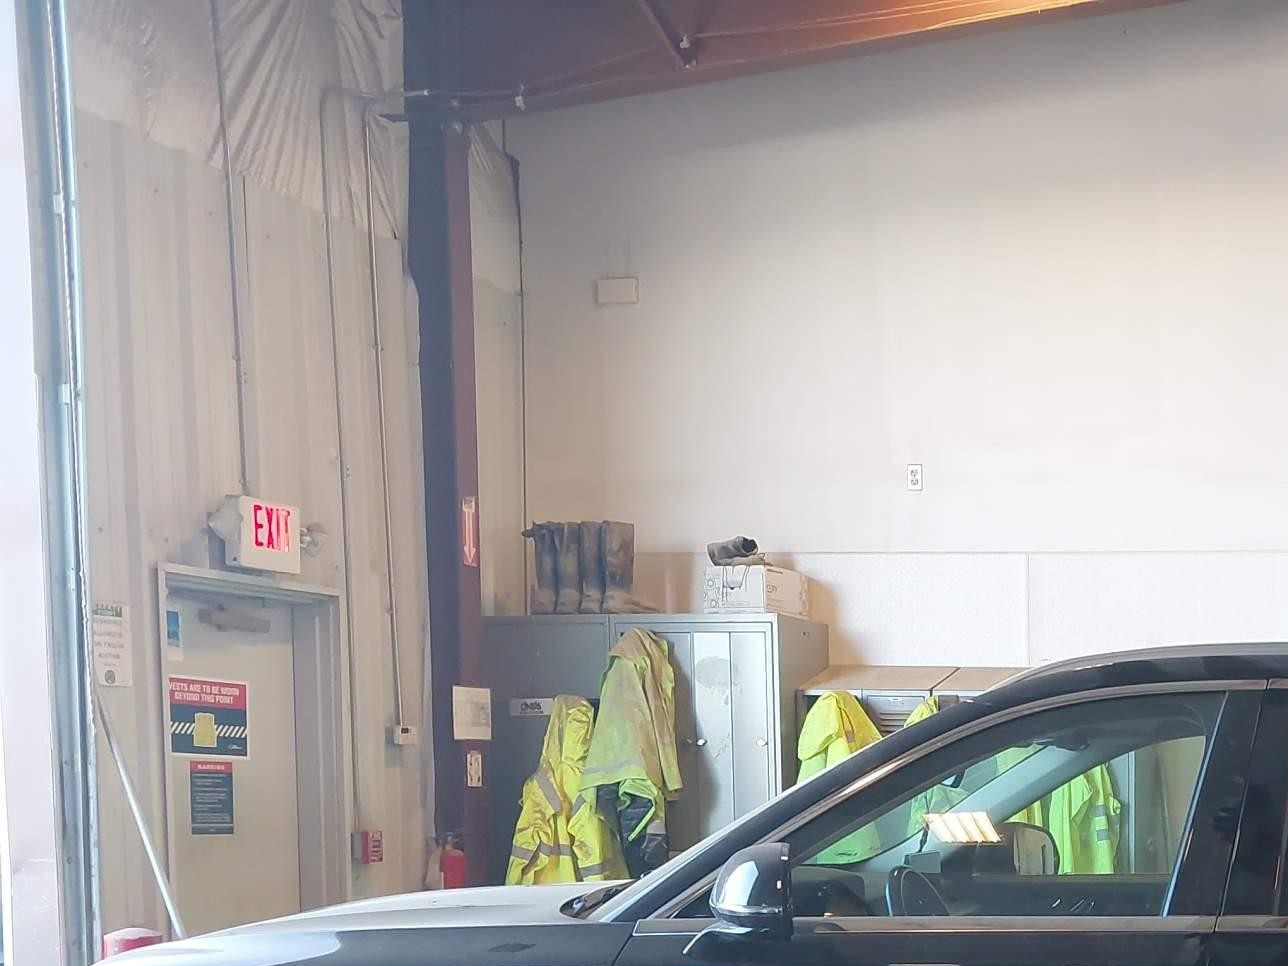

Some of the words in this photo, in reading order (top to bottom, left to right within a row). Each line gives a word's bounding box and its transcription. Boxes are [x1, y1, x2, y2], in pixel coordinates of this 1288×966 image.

[253, 504, 290, 552] EXIT
[169, 683, 188, 691] VESTS
[189, 684, 201, 693] ARE
[202, 685, 211, 693] TO
[212, 686, 220, 695] BE
[174, 692, 200, 701] BEYOND
[201, 694, 215, 703] THIS
[215, 695, 233, 704] POINT
